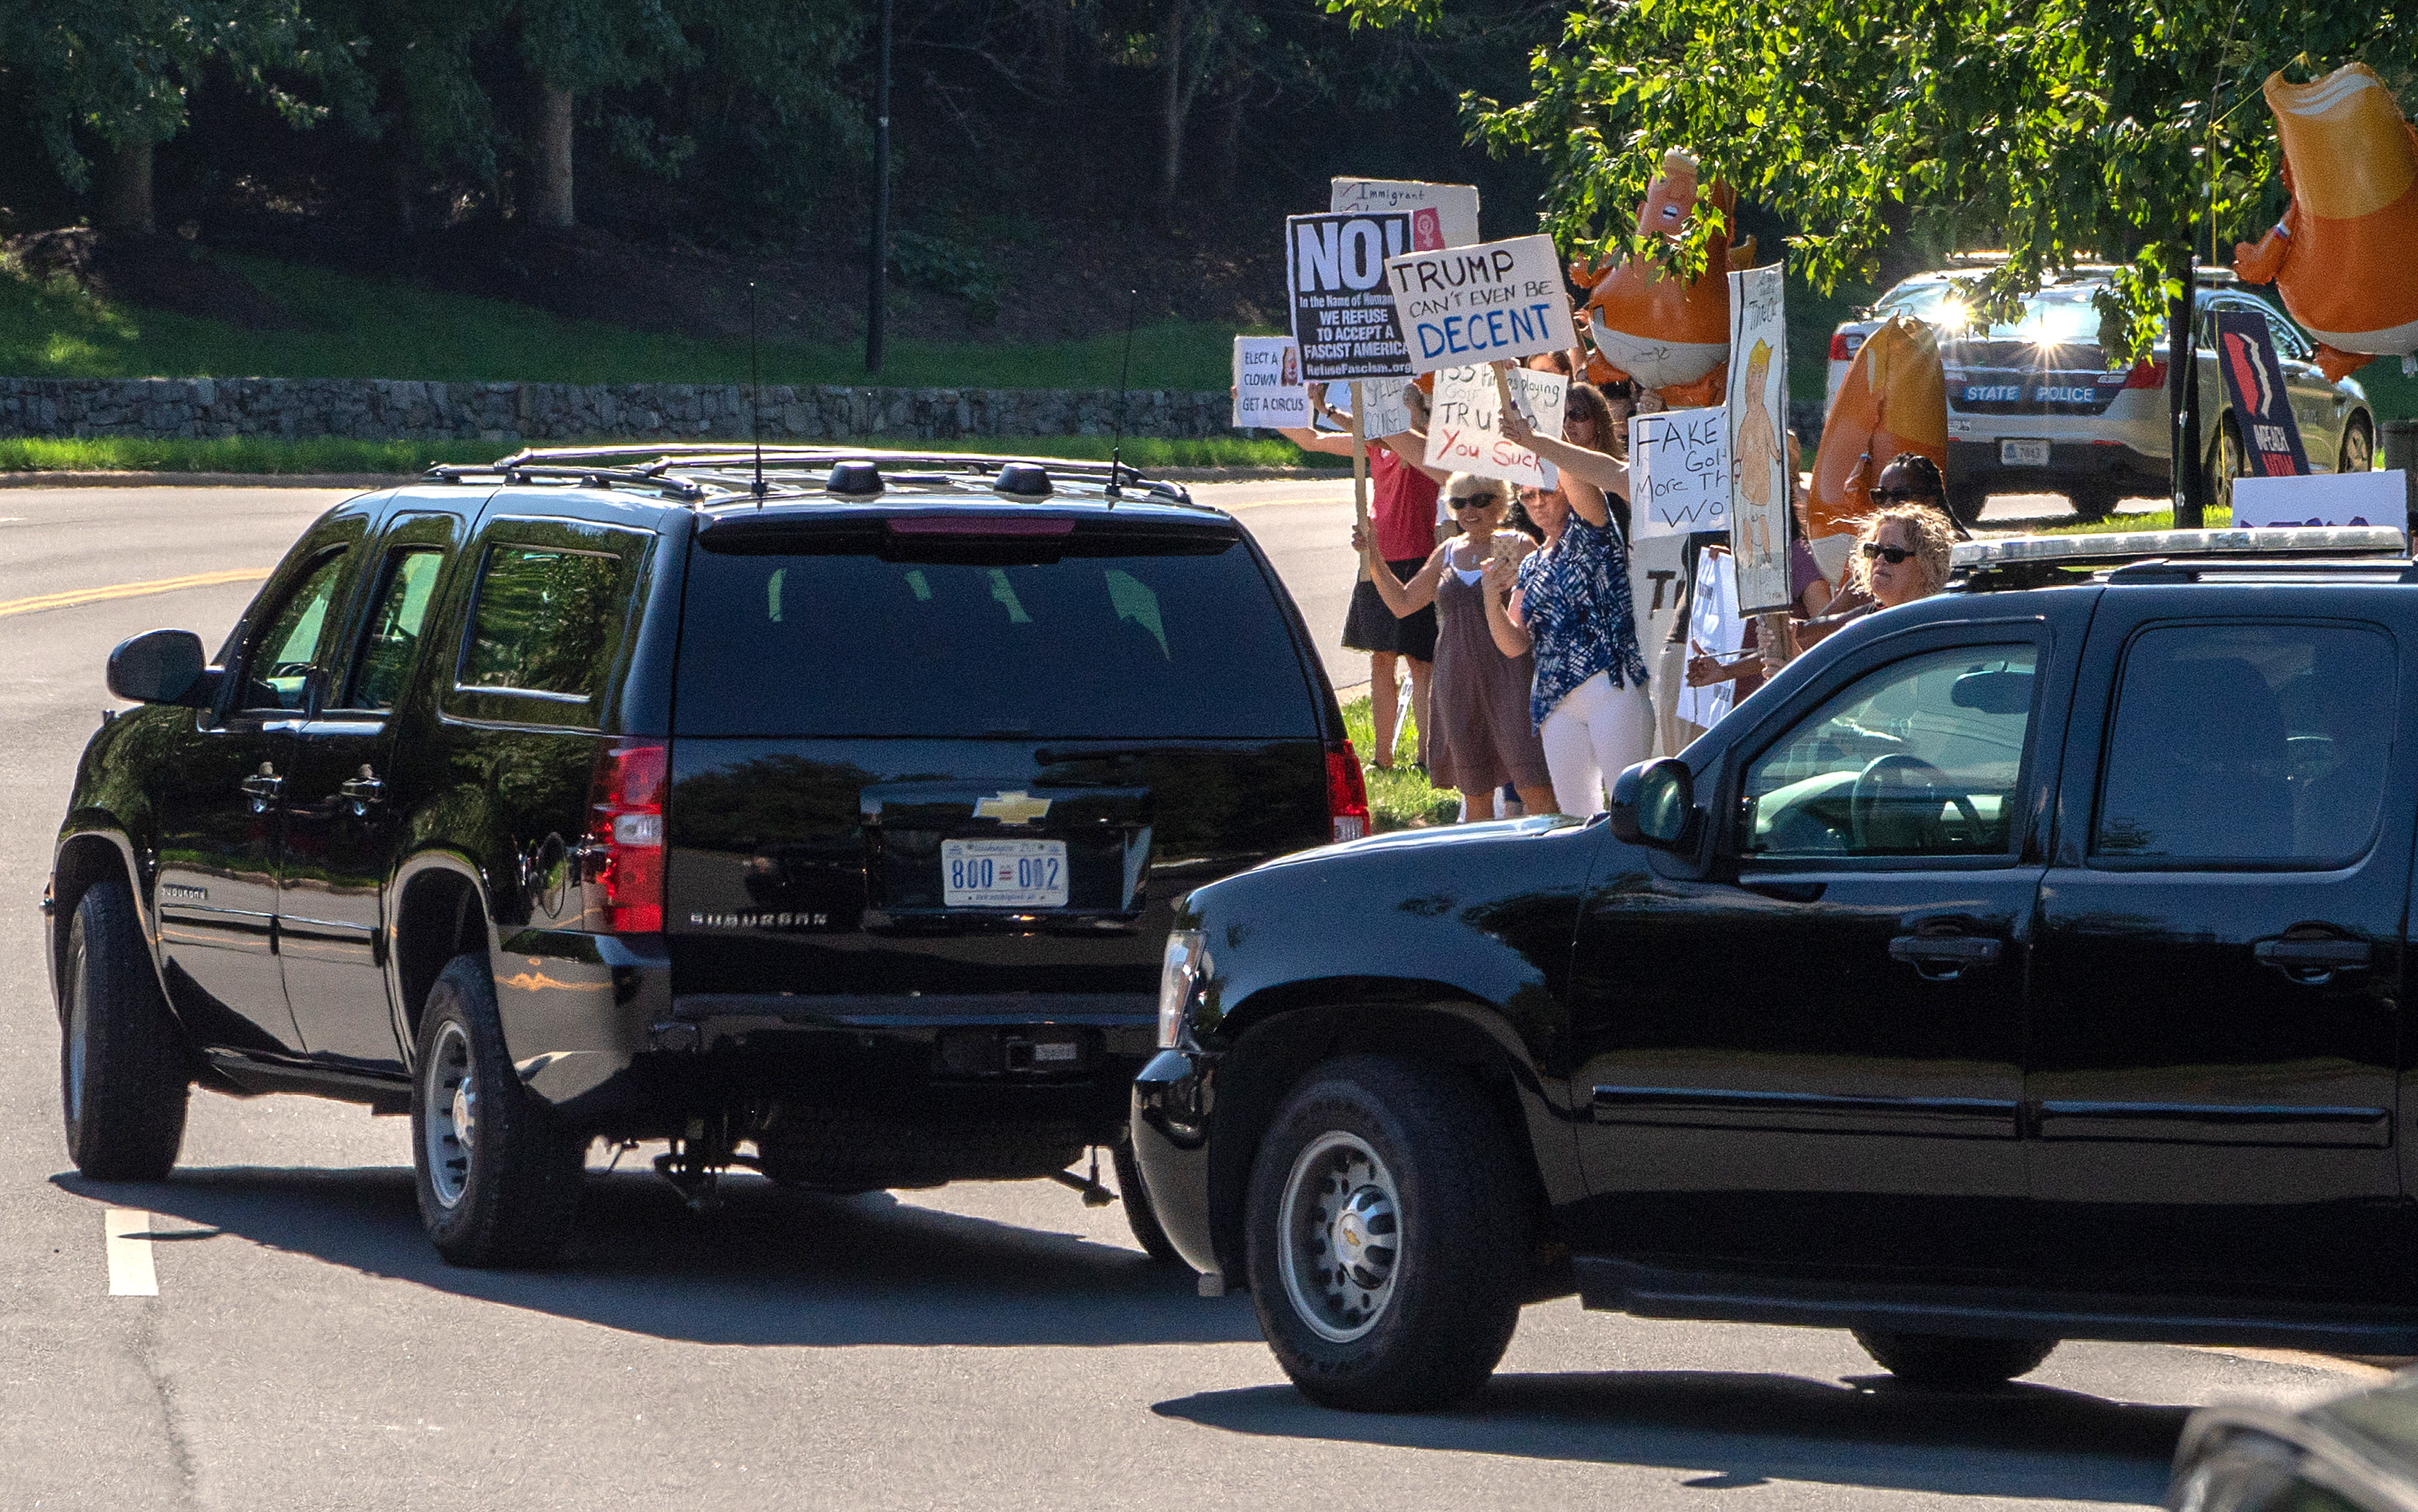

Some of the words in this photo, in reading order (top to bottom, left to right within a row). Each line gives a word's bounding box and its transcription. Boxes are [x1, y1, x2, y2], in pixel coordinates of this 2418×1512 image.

[1357, 182, 1425, 206] Immigrant
[1297, 219, 1403, 293] NO!
[1391, 250, 1515, 293] TRUMP
[1300, 296, 1308, 308] In
[1310, 295, 1324, 307] the
[1326, 294, 1350, 307] Name
[1351, 293, 1362, 307] of
[1409, 291, 1461, 318] CAN'T
[1470, 285, 1516, 305] EVEN
[1523, 280, 1554, 298] BE
[1319, 310, 1340, 325] WE
[1342, 308, 1388, 325] REFUSE
[1316, 327, 1333, 341] TO
[1335, 325, 1382, 341] ACCEPT
[1384, 325, 1395, 339] A
[1416, 303, 1551, 358] DECENT
[1245, 352, 1268, 365] ELECT
[1271, 353, 1278, 365] A
[1303, 344, 1351, 360] FASCIST
[1353, 341, 1409, 358] AMERICA
[1244, 374, 1277, 386] CLOWN
[1521, 374, 1560, 408] playing
[1242, 397, 1261, 411] GET
[1262, 398, 1269, 411] A
[1270, 397, 1304, 412] CIRCUS
[1967, 386, 2020, 401] STATE
[2037, 387, 2095, 401] POLICE
[1437, 428, 1480, 460] You
[1492, 441, 1545, 475] Suck
[1635, 475, 1688, 504] More
[952, 859, 993, 889] 800
[1018, 857, 1059, 890] 002
